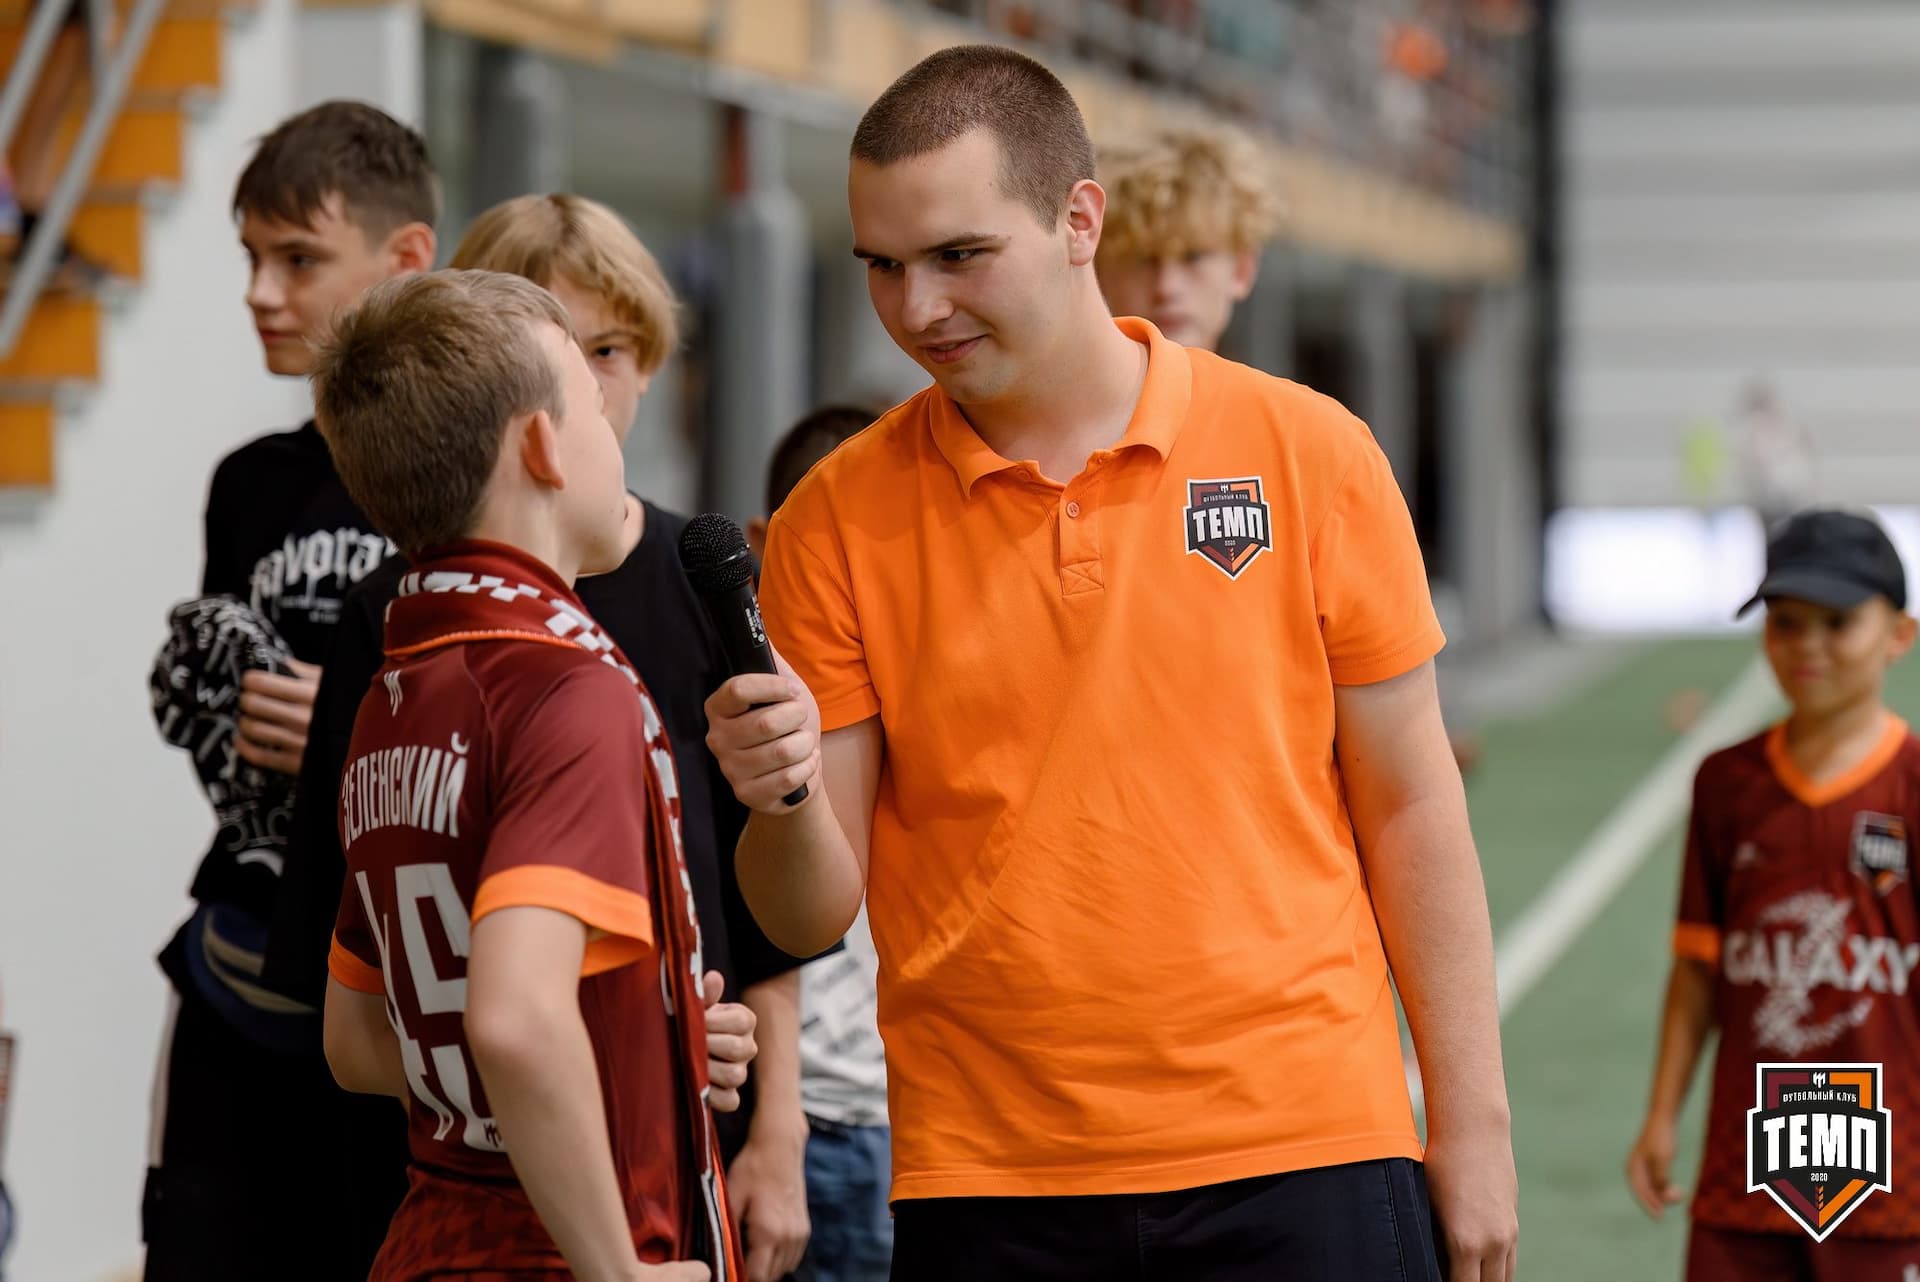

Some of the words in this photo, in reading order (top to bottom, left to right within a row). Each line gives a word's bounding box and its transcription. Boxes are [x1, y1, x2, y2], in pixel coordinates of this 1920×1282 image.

[1193, 506, 1264, 542] ТЕМП
[342, 731, 470, 850] ЗЕЛЕНСКИЙ
[1723, 930, 1920, 996] GALAXY
